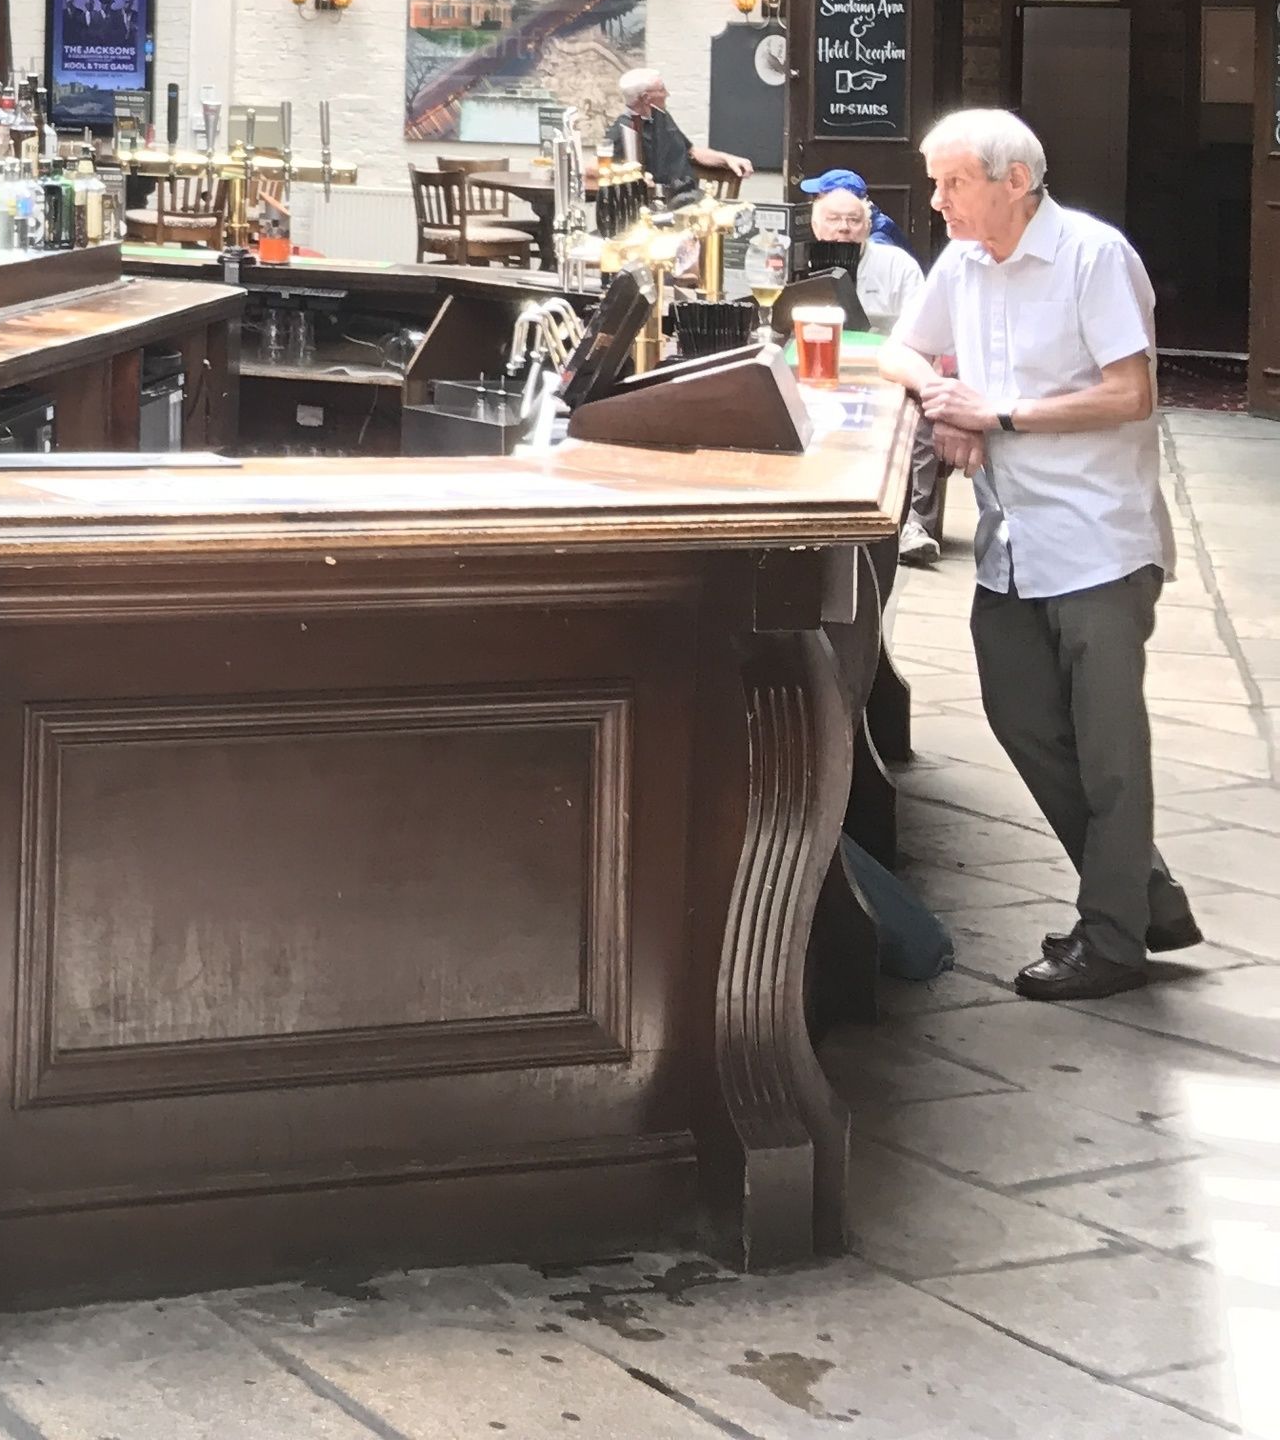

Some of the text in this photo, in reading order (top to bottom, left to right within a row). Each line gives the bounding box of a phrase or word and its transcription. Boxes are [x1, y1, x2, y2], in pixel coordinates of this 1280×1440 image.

[63, 45, 137, 56] THE JACKSONS
[818, 36, 906, 65] Hotel Reception
[63, 62, 87, 71] KOOL
[93, 62, 110, 71] THE
[110, 63, 135, 71] GANG
[829, 103, 889, 116] UPSTAIRS
